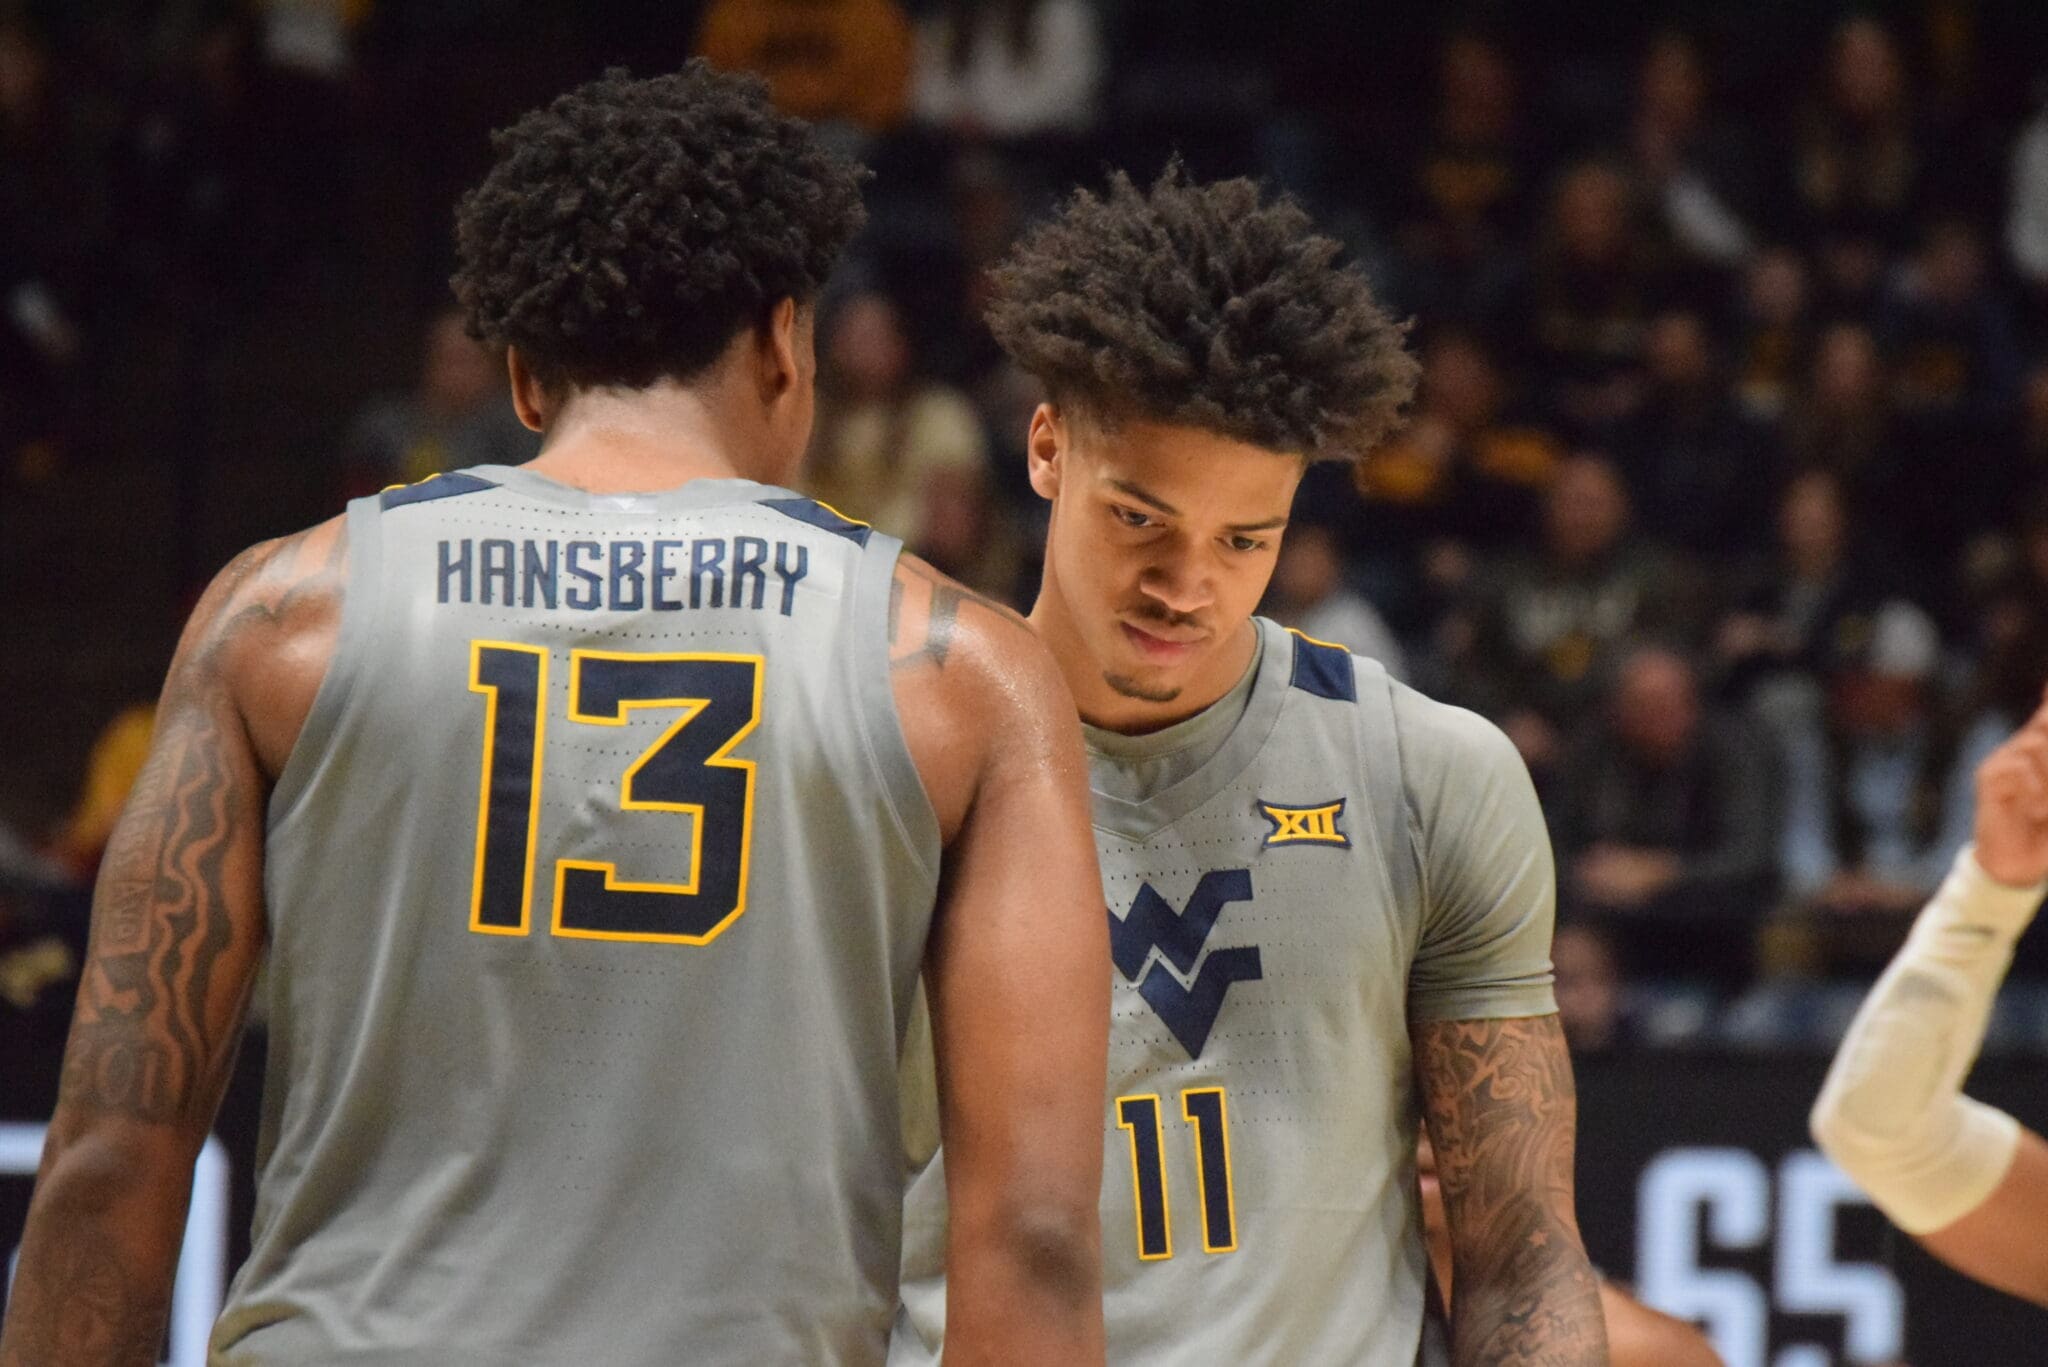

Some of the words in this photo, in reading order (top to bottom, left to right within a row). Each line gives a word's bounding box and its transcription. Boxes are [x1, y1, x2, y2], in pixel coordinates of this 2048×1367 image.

[437, 537, 808, 616] HANSBERRY
[468, 639, 765, 946] 13
[1260, 800, 1349, 846] XII
[1115, 1086, 1238, 1260] 11
